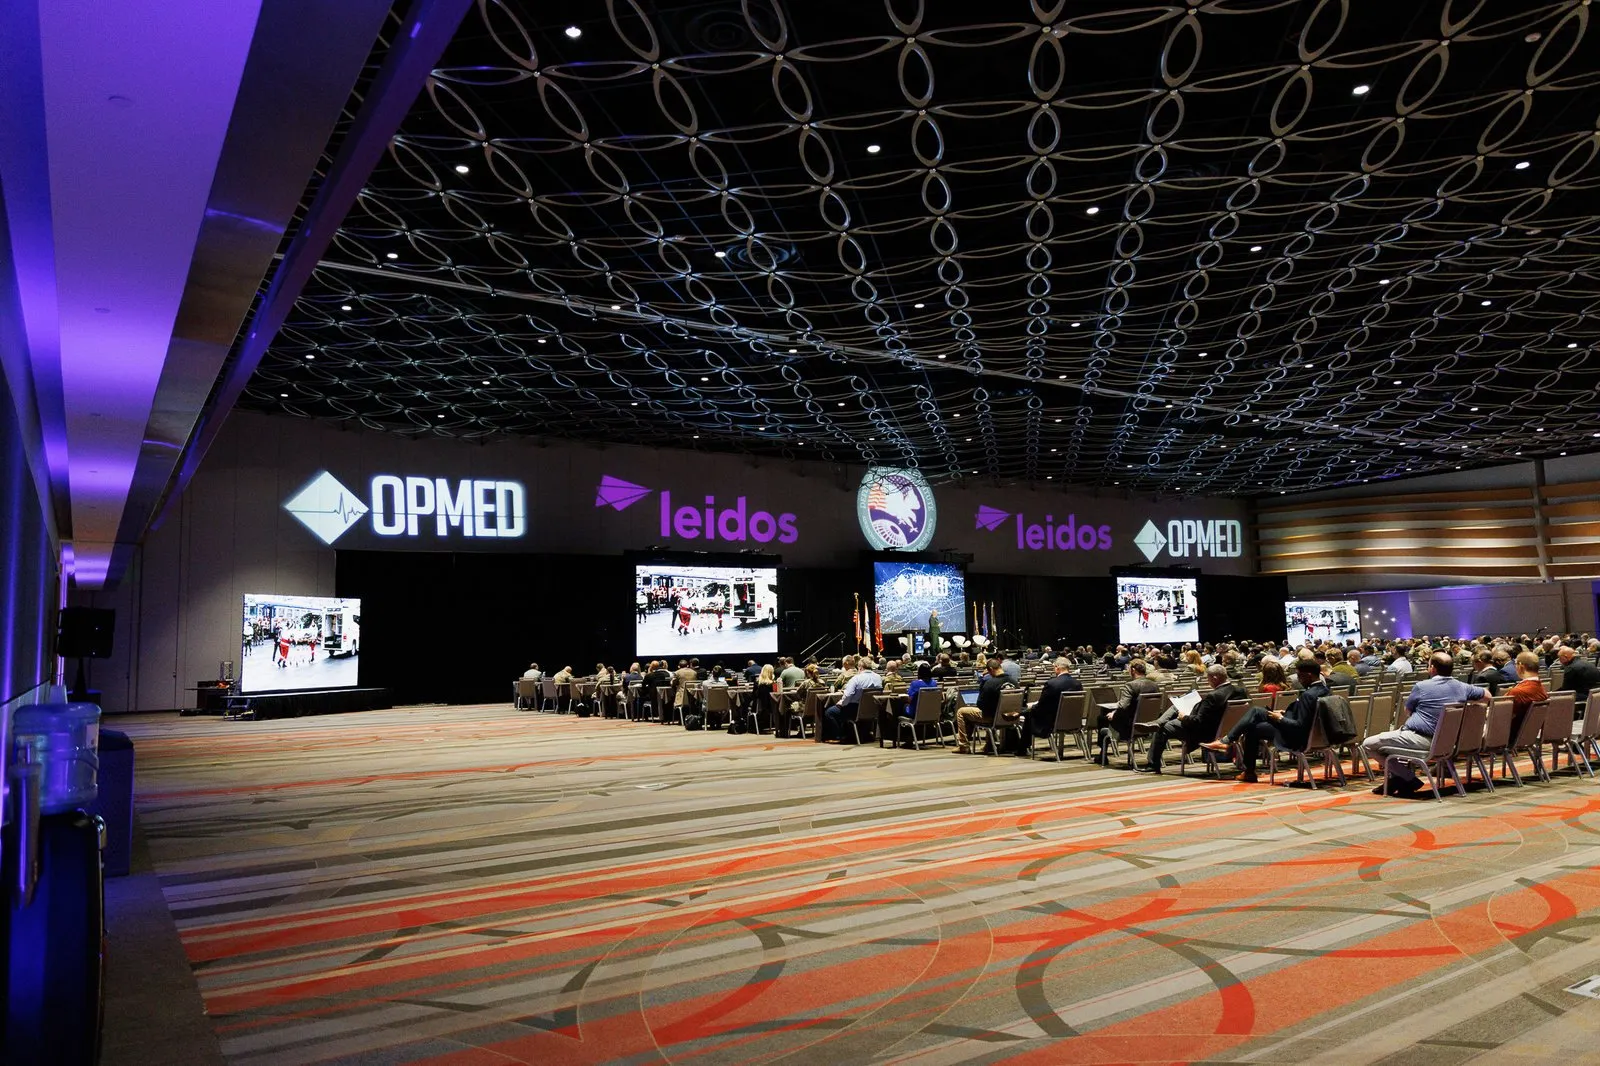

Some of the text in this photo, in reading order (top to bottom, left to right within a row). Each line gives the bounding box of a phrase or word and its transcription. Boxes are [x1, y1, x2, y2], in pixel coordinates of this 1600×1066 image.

[371, 475, 526, 537] OPMED
[659, 489, 799, 544] leidos
[1016, 513, 1113, 550] leidos
[1167, 519, 1242, 557] OPMED
